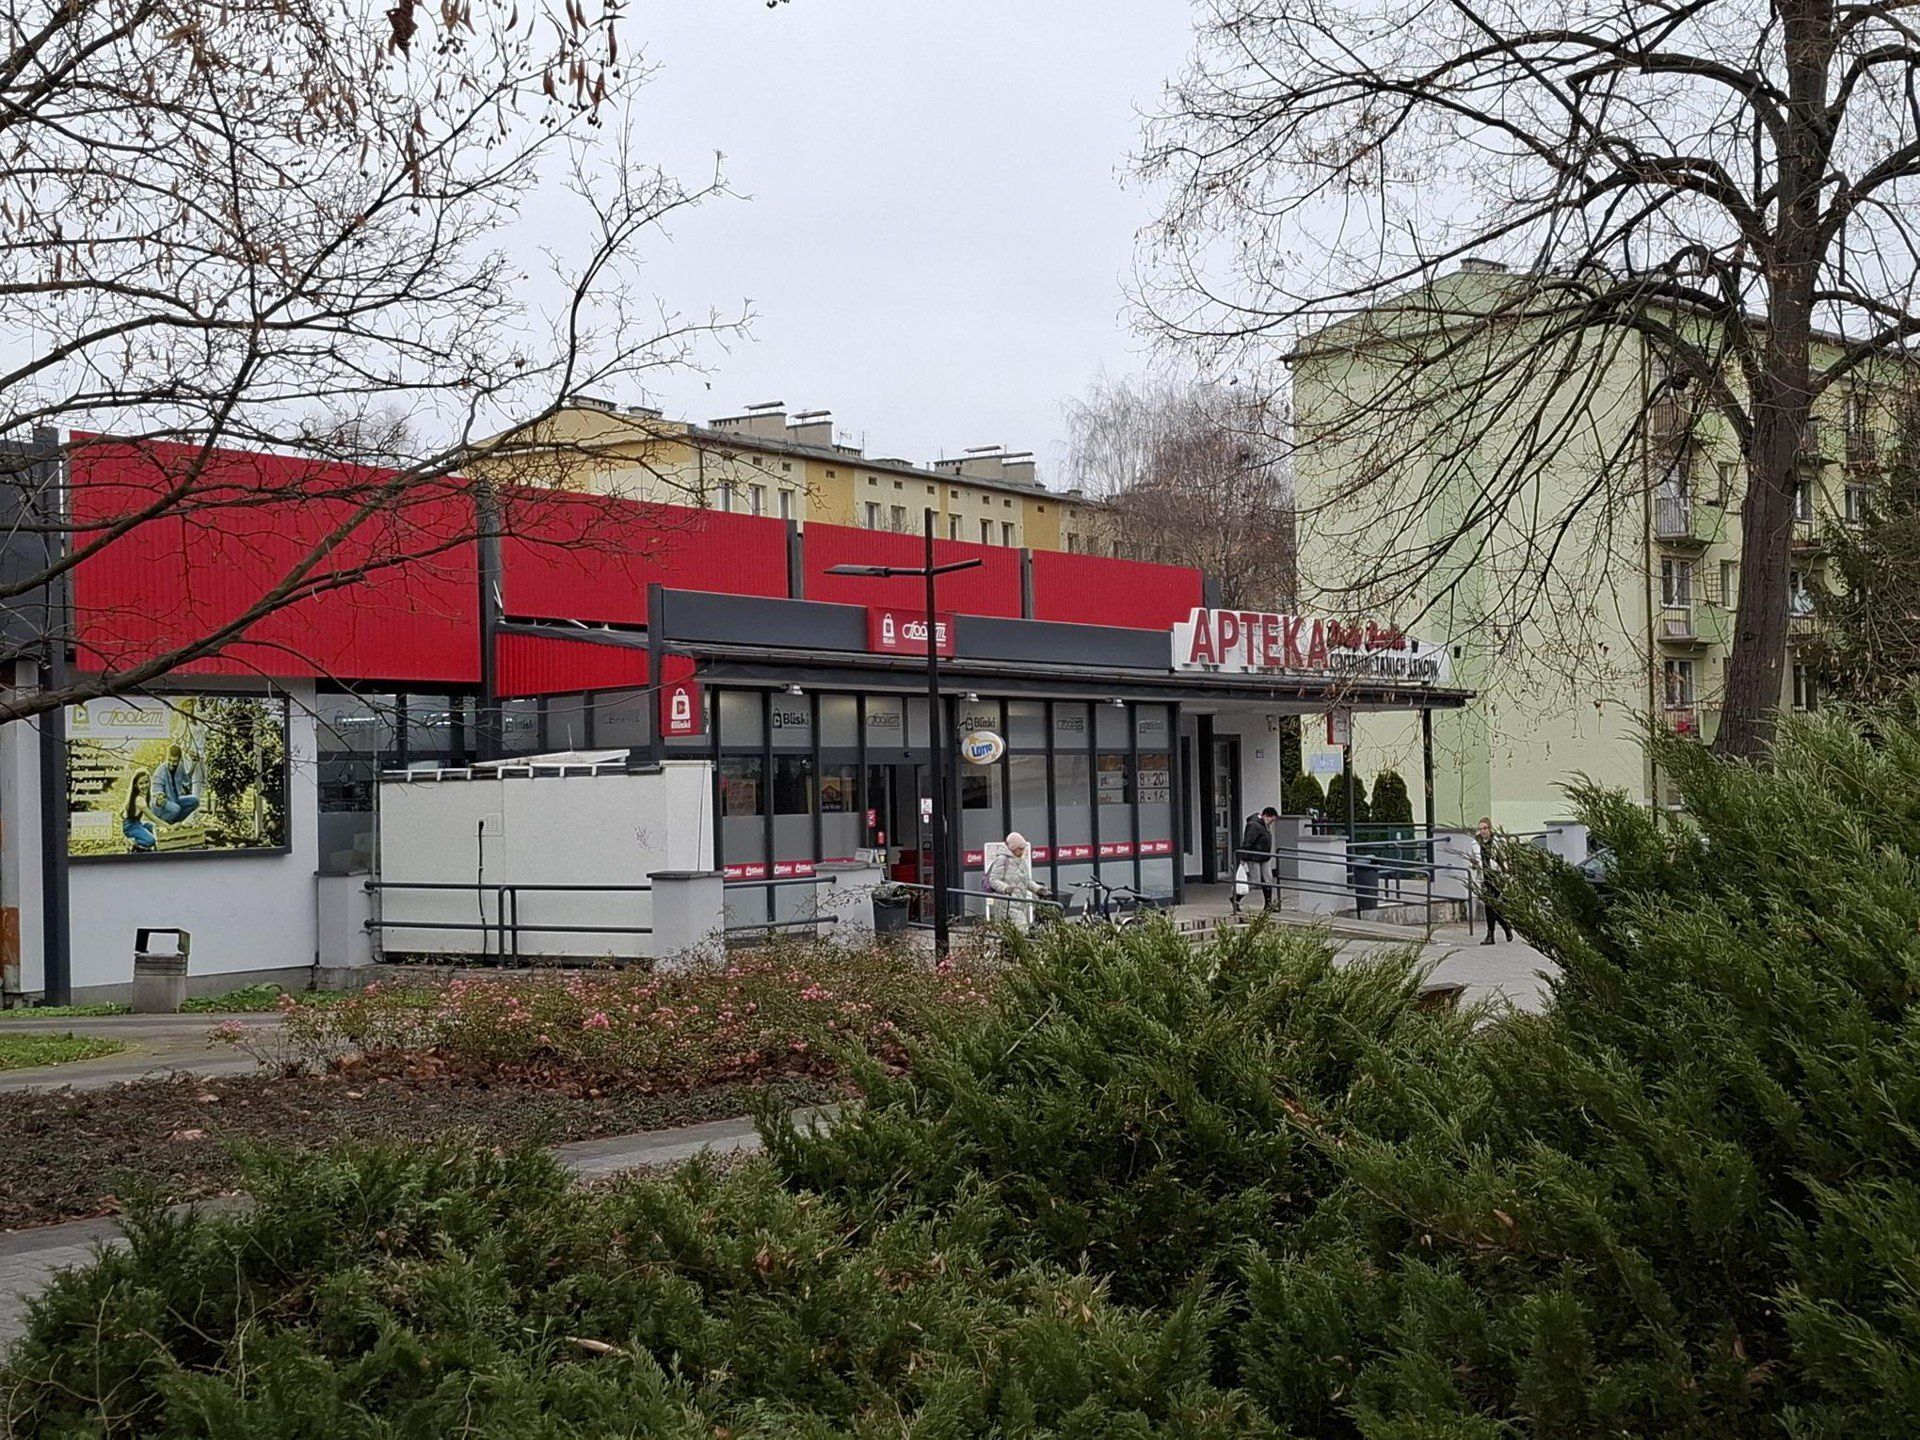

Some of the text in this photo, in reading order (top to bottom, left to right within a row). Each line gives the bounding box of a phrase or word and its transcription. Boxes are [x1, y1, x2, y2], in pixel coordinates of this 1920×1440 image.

[1189, 608, 1330, 669] APTEKA
[970, 743, 993, 758] LOTTO
[73, 826, 110, 838] POLSKI
